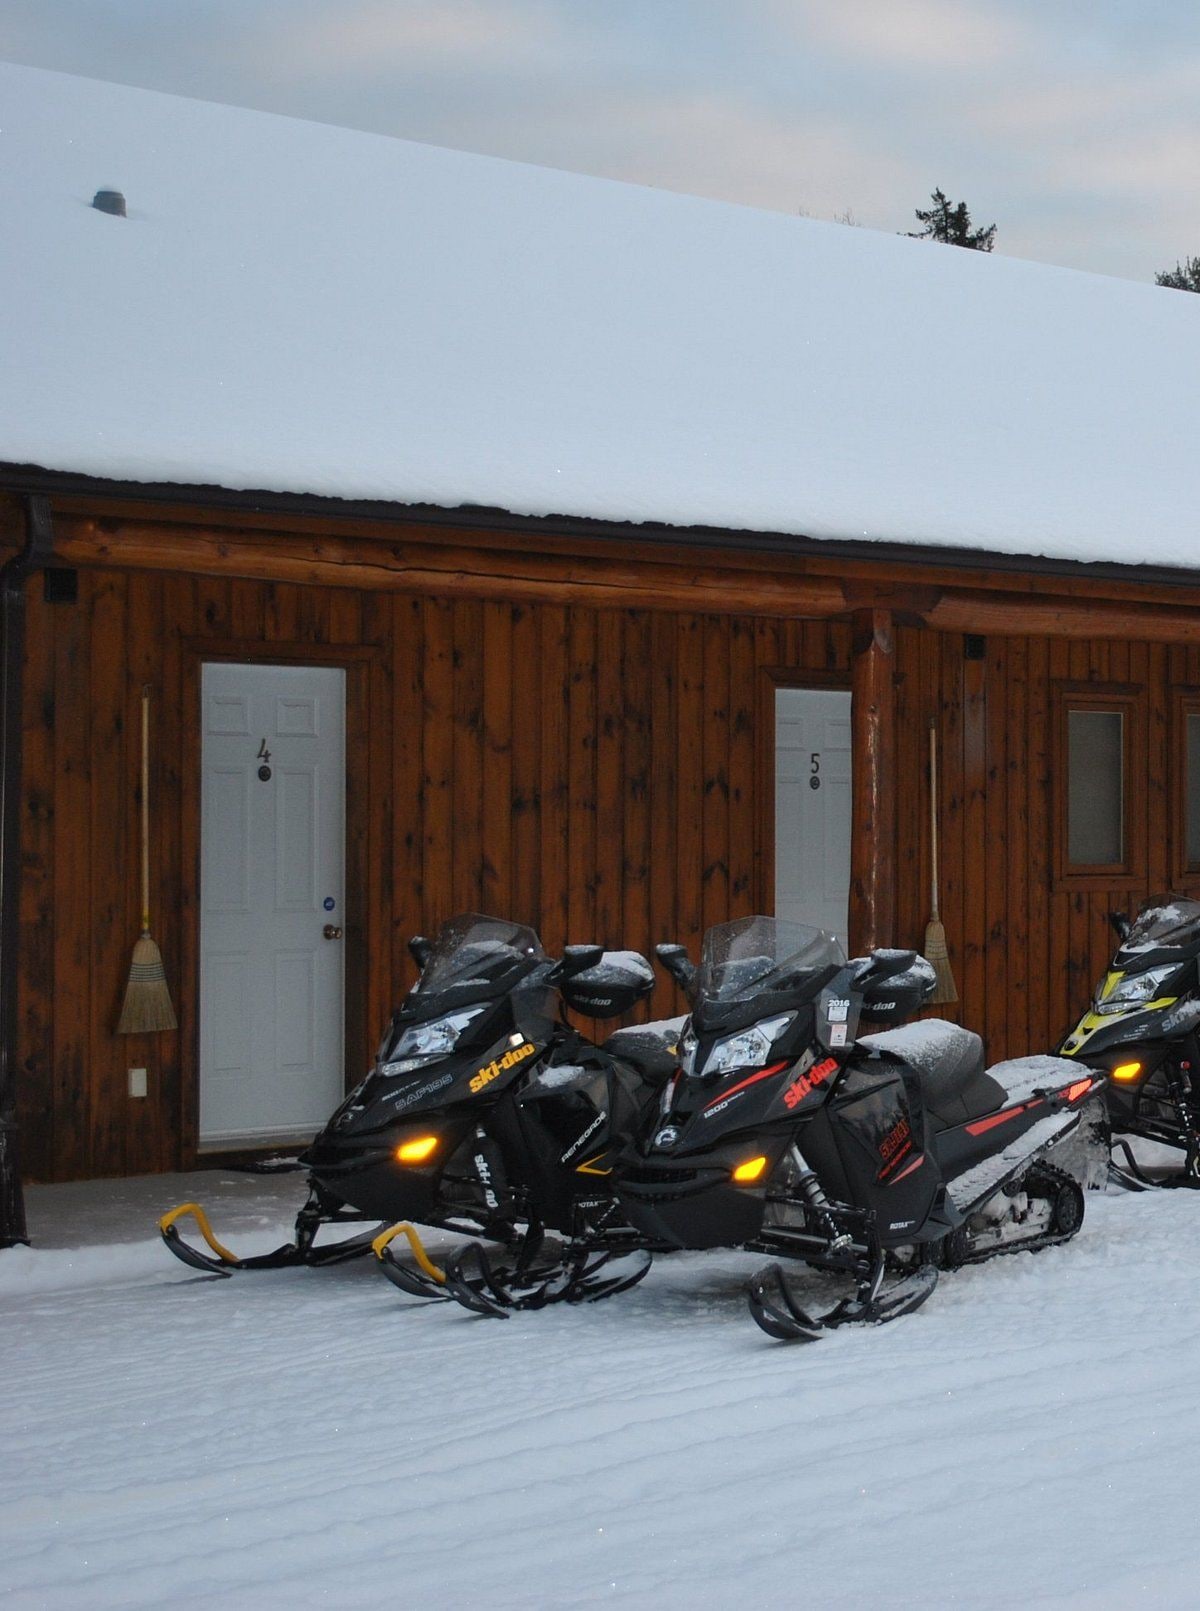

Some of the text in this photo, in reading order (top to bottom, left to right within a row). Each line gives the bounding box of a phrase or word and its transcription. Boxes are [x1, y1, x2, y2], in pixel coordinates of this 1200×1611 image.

[257, 738, 271, 763] 4
[811, 753, 820, 774] 5
[828, 999, 851, 1007] 2016
[468, 1043, 536, 1093] ski-doo
[784, 1057, 840, 1109] ski-doo
[703, 1100, 728, 1119] 1200
[561, 1110, 607, 1163] RENEGADE
